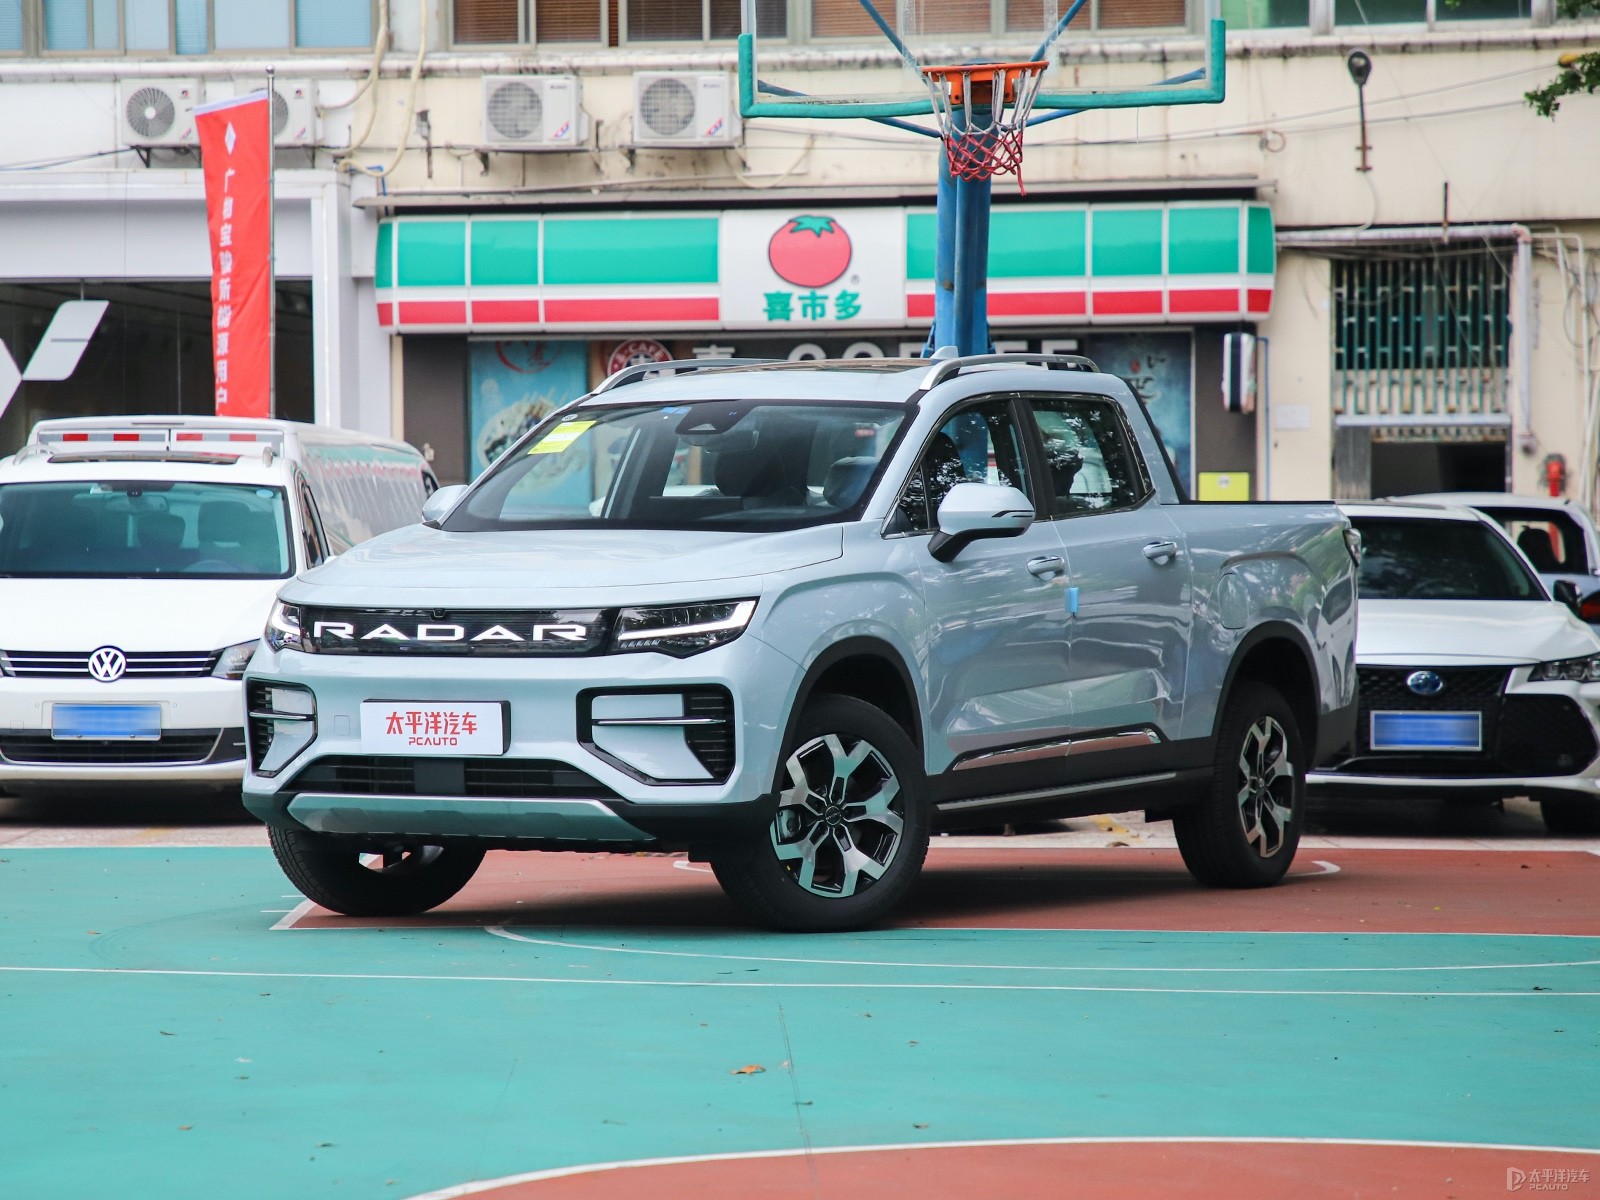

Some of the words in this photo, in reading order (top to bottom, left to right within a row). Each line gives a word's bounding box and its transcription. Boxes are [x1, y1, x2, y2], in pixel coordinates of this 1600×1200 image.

[763, 289, 862, 321] 喜市多
[313, 621, 588, 641] RADAR
[385, 711, 478, 735] 太平洋汽车
[408, 737, 458, 746] PCAUTO
